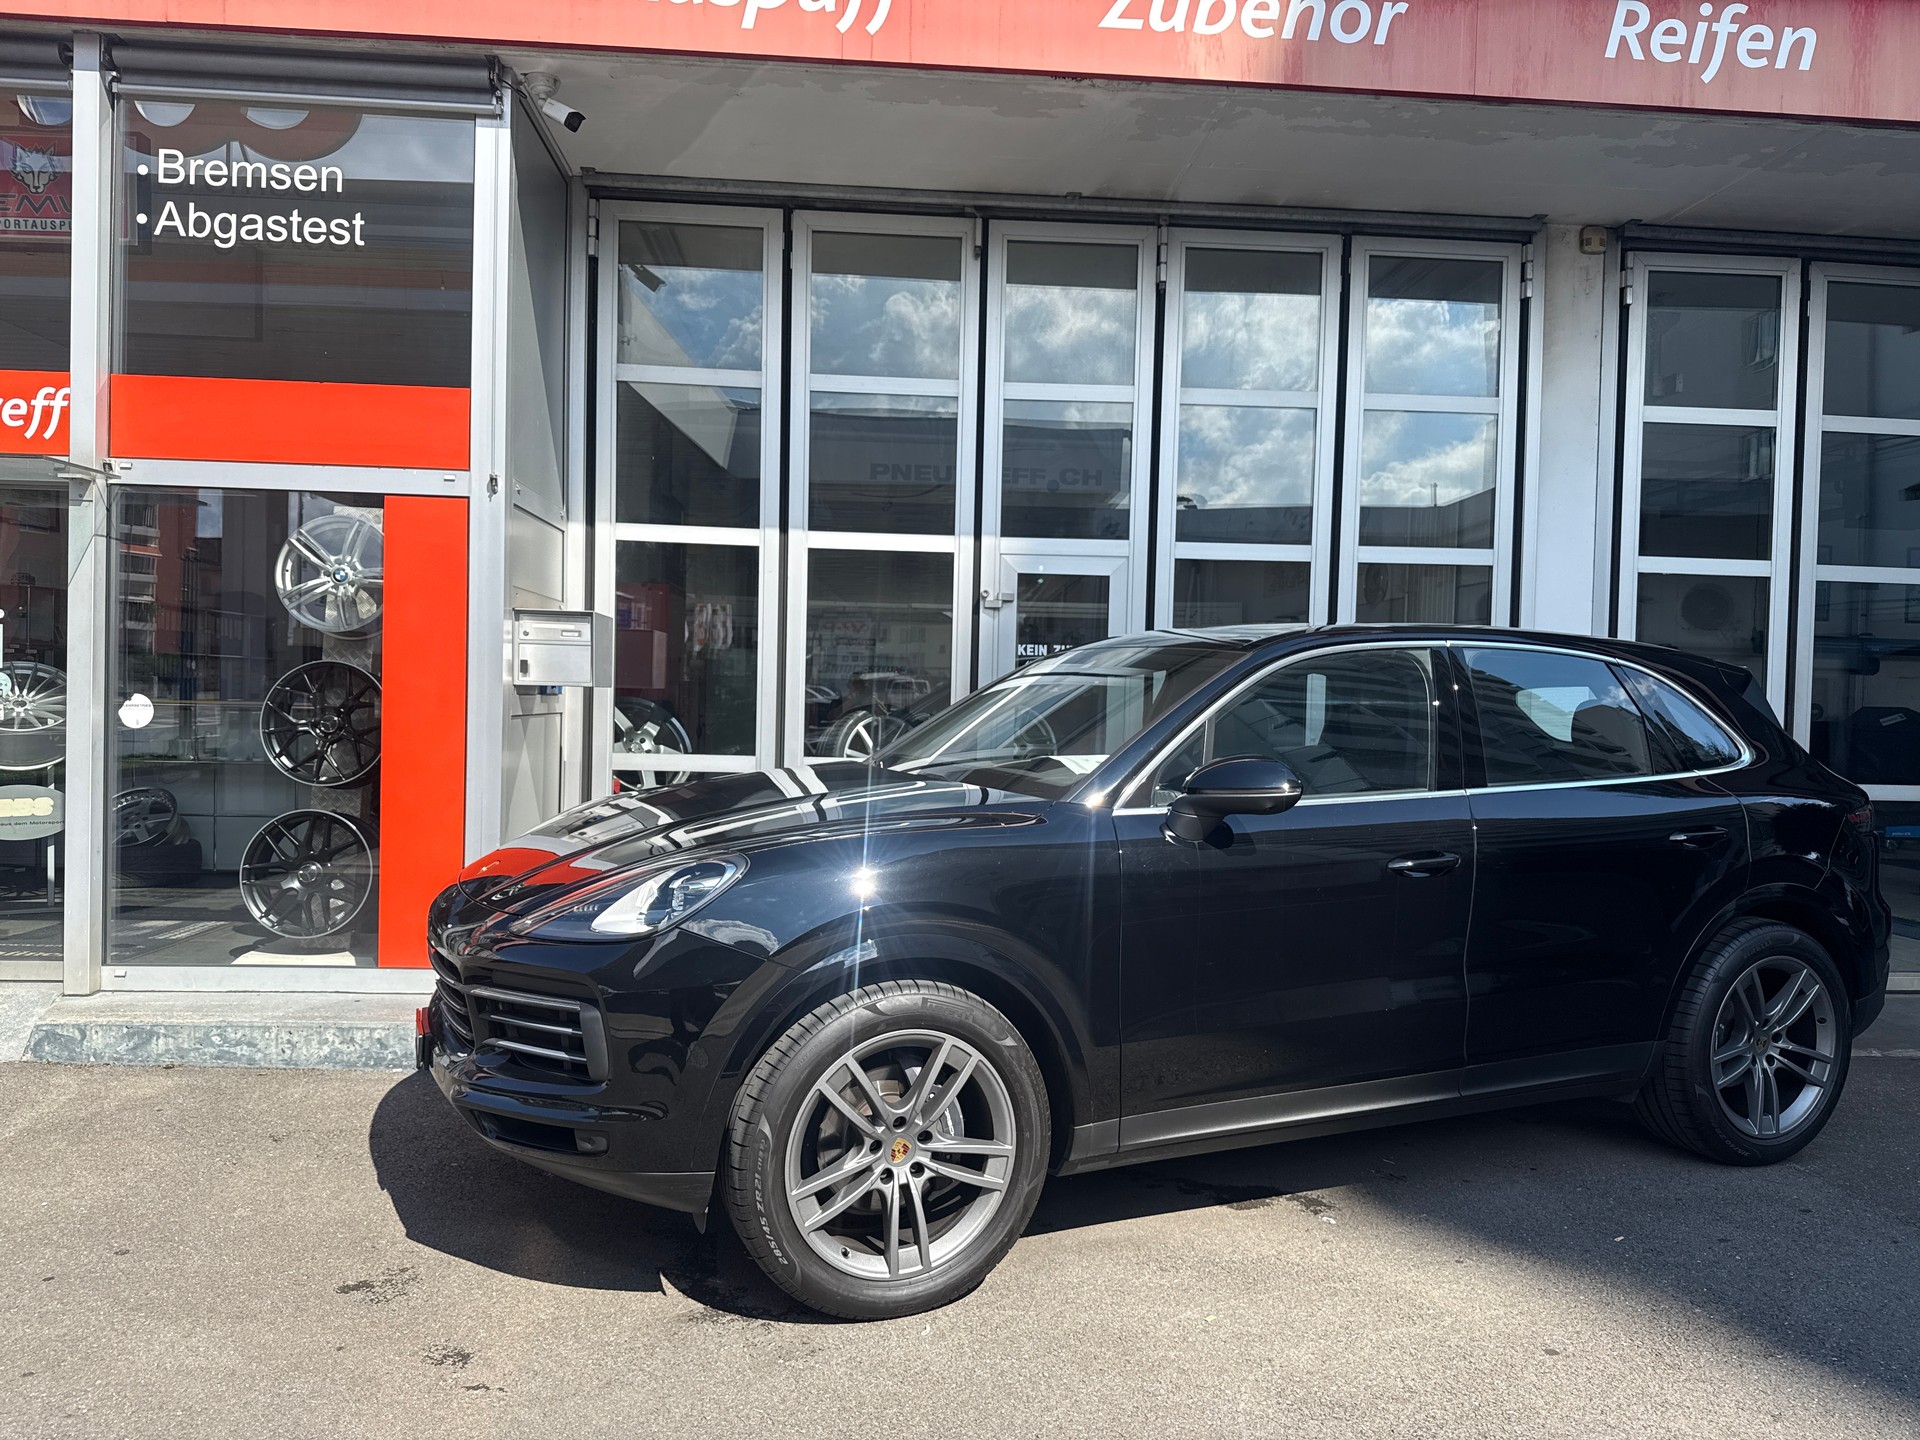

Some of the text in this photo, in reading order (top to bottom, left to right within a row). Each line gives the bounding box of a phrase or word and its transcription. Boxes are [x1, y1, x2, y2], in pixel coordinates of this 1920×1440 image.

[1604, 0, 1818, 84] Reifen
[157, 148, 344, 193] Bremsen
[153, 200, 366, 249] Abgastest
[0, 386, 71, 440] eff
[870, 462, 1104, 492] PNEUEFF.CH
[1017, 643, 1048, 656] KEIN
[754, 1172, 766, 1213] ZR21
[759, 1216, 789, 1266] 285/45
